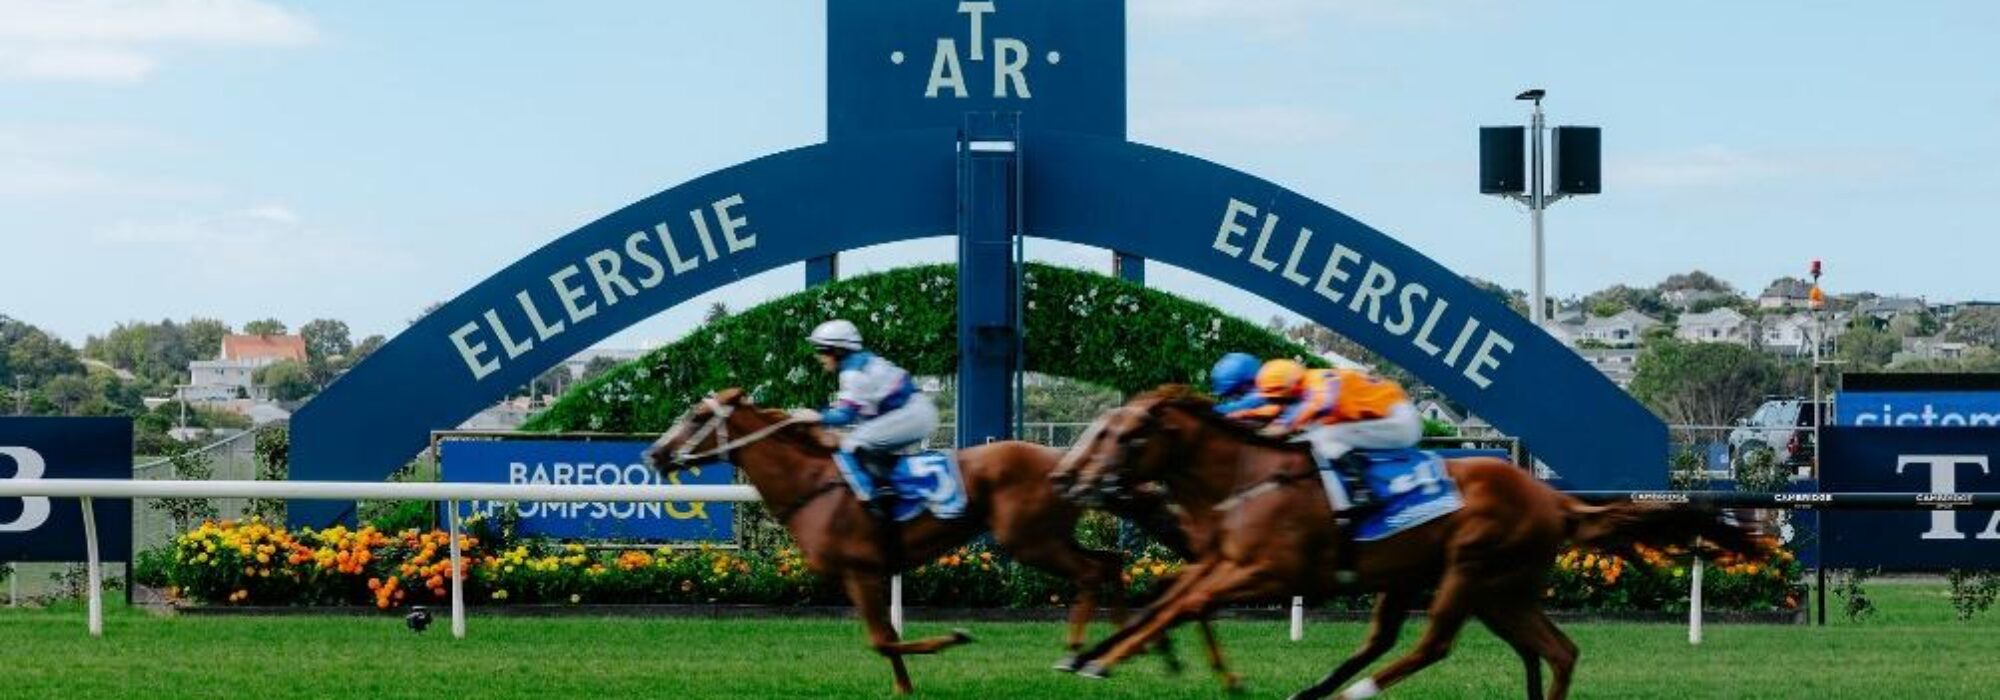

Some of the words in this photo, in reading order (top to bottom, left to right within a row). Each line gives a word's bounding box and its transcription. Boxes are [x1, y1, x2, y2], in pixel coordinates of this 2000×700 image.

[449, 193, 757, 381] ELLERSLIE
[1212, 198, 1514, 389] ELLERSLIE
[1774, 493, 1832, 501] CAMBRIDGE
